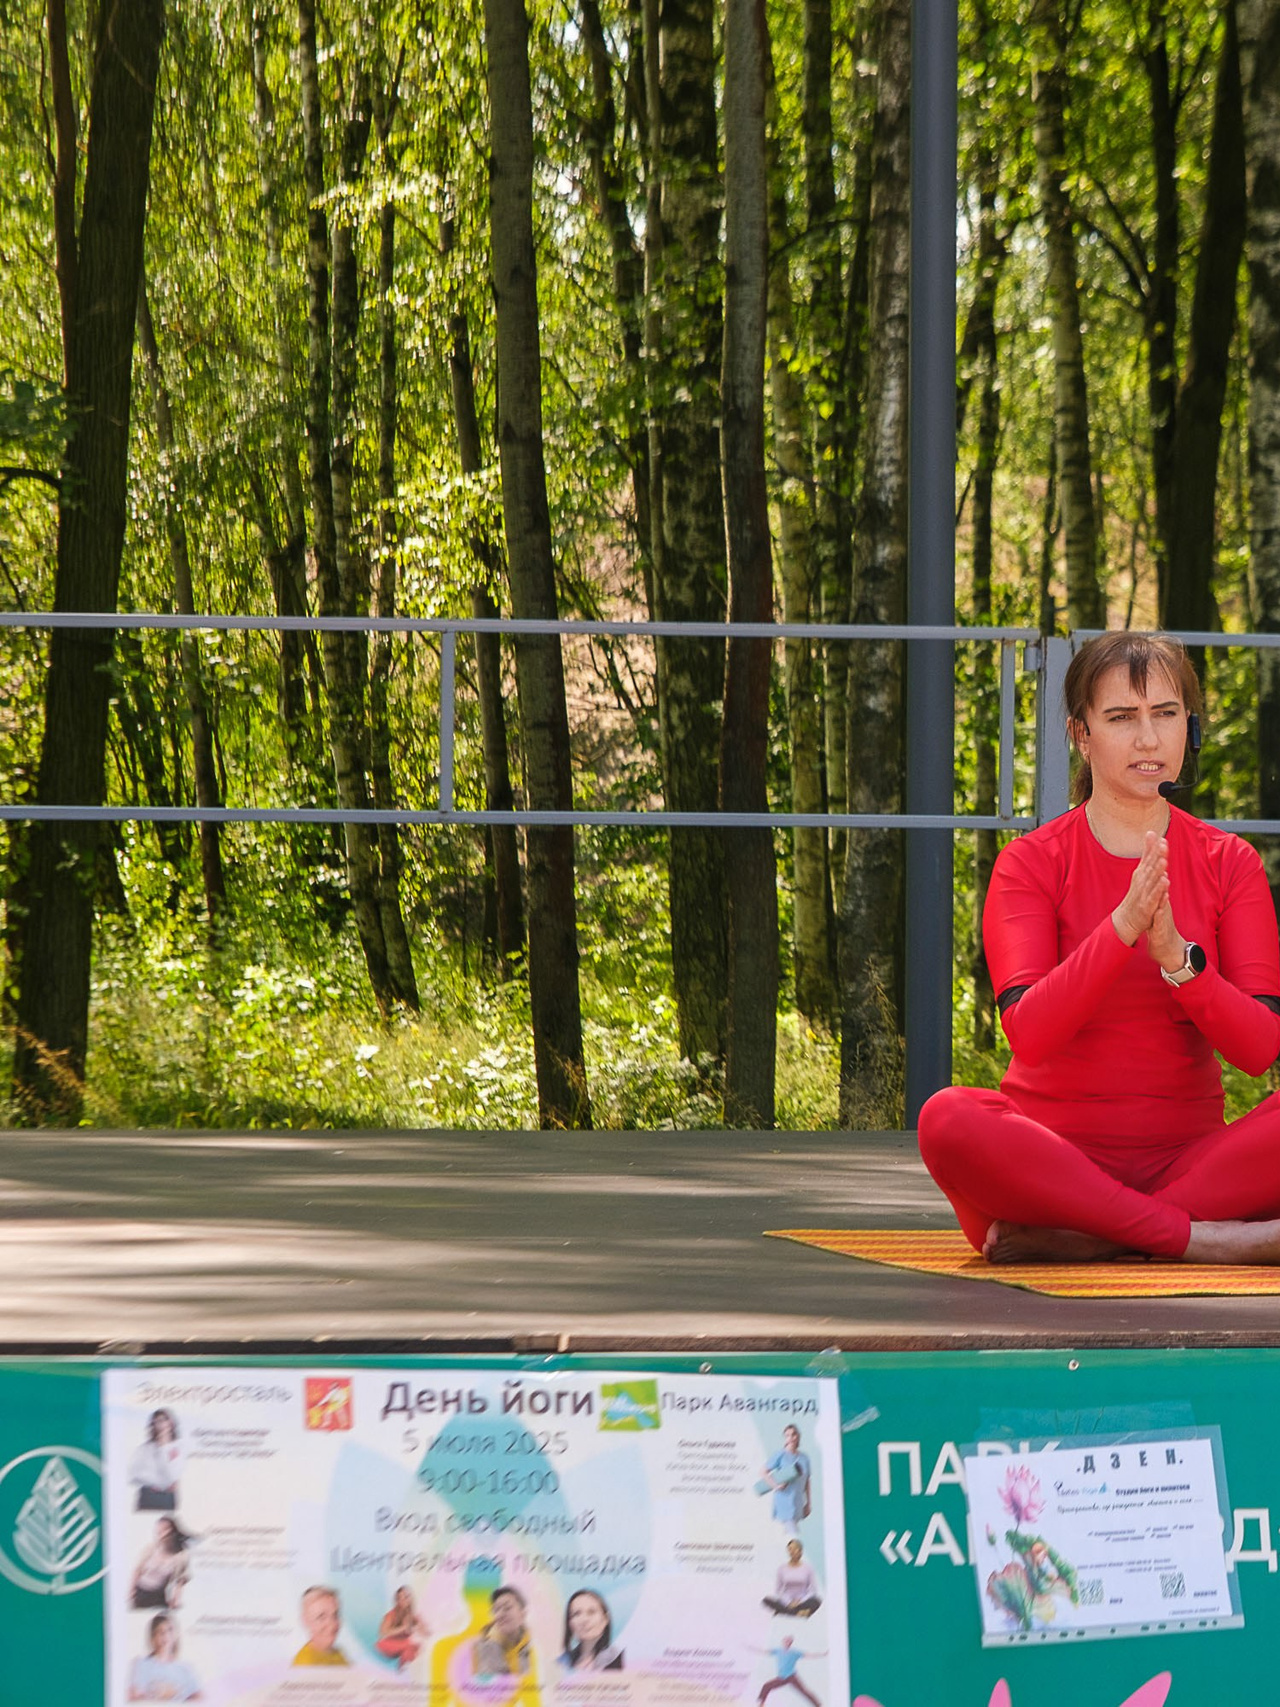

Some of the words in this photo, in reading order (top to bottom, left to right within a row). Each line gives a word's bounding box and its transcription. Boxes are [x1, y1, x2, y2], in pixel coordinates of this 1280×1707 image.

[380, 1381, 489, 1421] День
[501, 1379, 593, 1416] йоги
[661, 1391, 713, 1416] Парк
[718, 1393, 819, 1417] Авангард
[402, 1429, 419, 1454] 5
[426, 1434, 496, 1454] июля
[503, 1430, 569, 1455] 2025
[417, 1468, 560, 1495] 9:00-16:00
[877, 1441, 1061, 1496] ПА
[374, 1505, 438, 1536] Вход
[444, 1507, 597, 1537] свободный
[330, 1546, 502, 1576] Центральная
[511, 1554, 647, 1578] площадка
